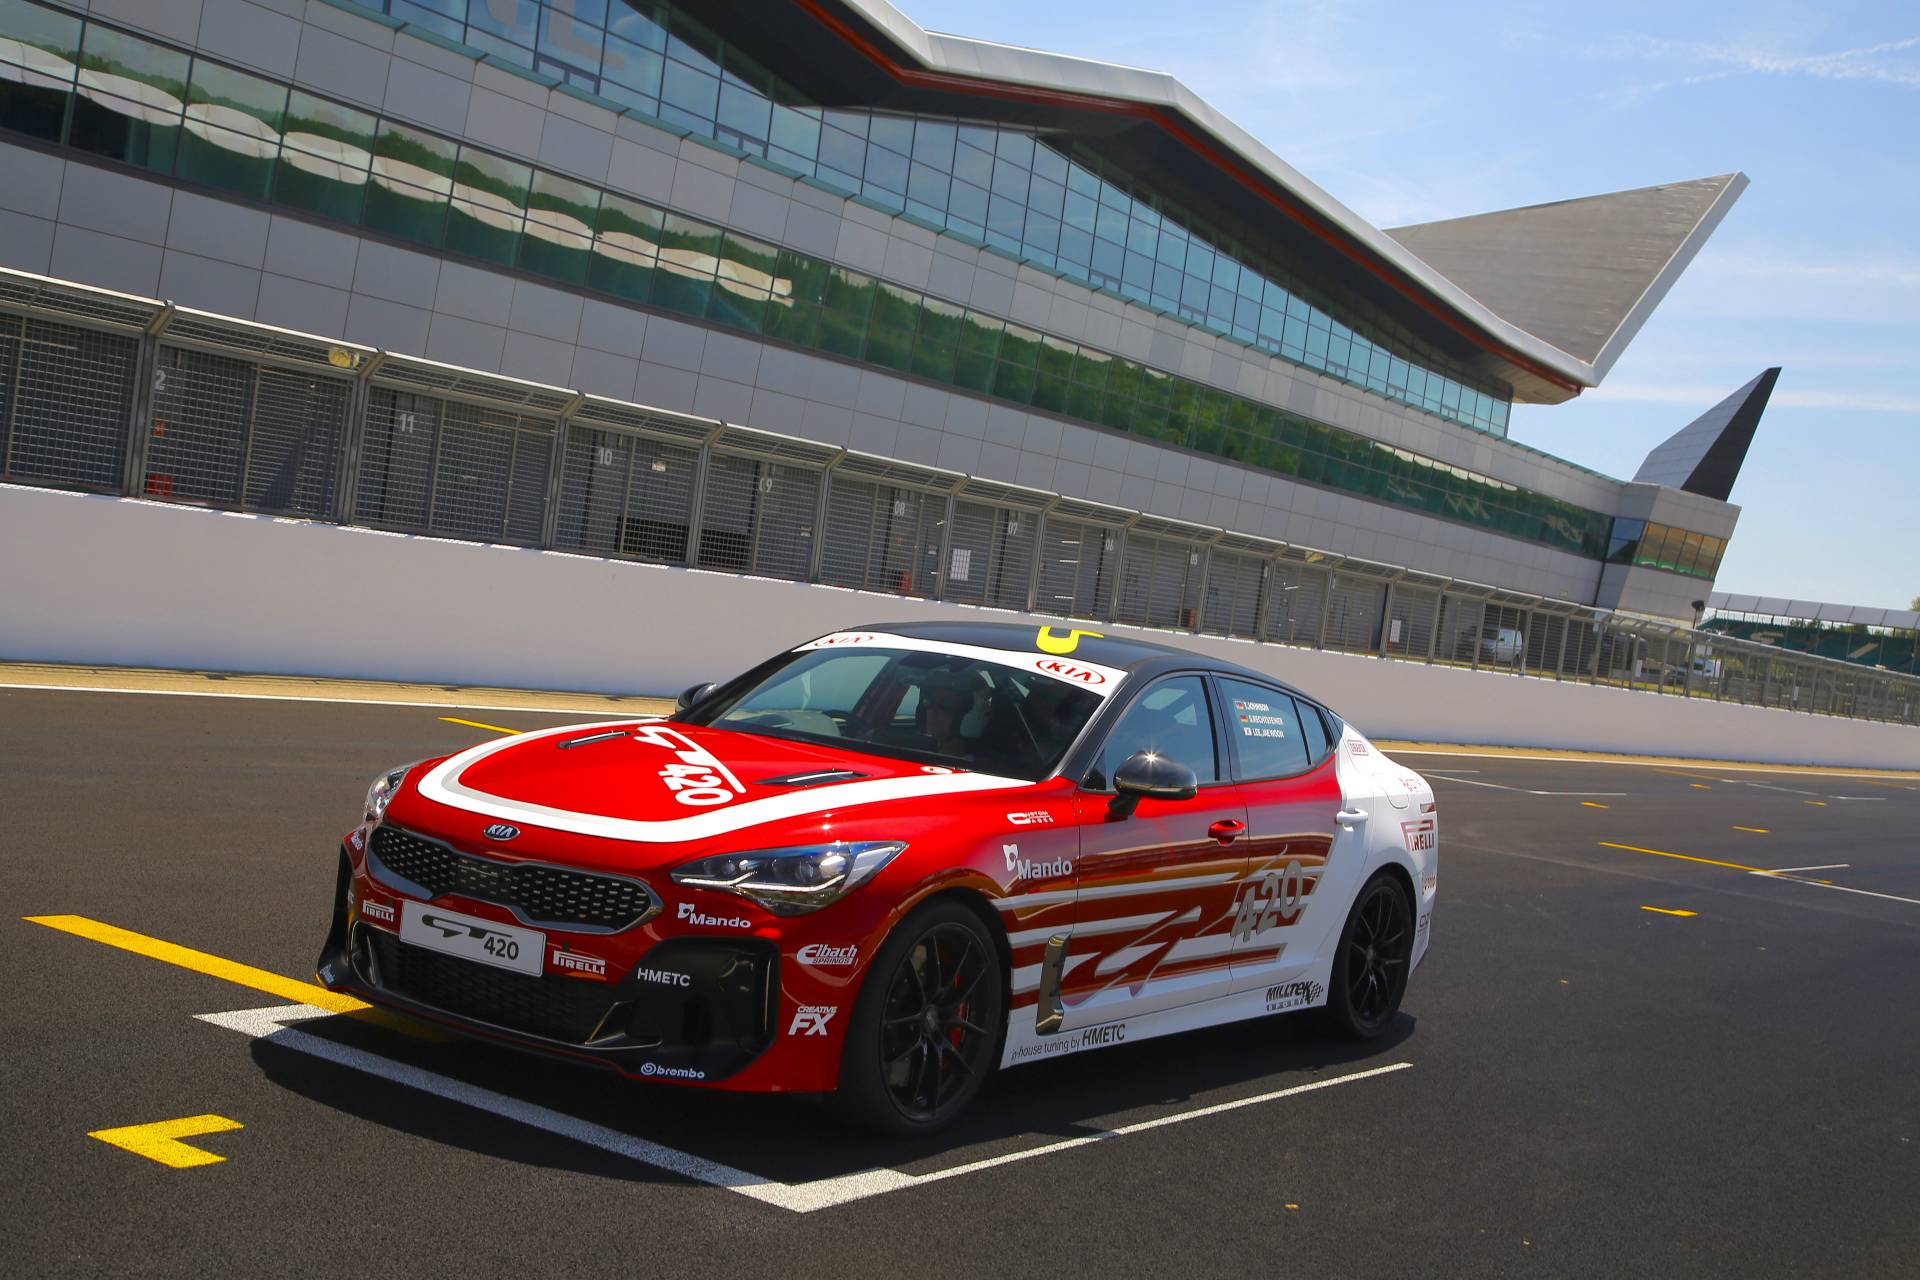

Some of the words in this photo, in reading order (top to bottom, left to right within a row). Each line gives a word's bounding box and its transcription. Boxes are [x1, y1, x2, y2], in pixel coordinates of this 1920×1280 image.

[400, 413, 415, 433] 11
[598, 446, 613, 466] 10
[1045, 661, 1092, 682] KIA
[486, 824, 514, 838] KIA
[1401, 819, 1435, 852] PIRELLI
[1016, 856, 1073, 880] Mando
[363, 899, 395, 922] PIRELLI
[689, 913, 752, 929] Mando
[483, 936, 520, 961] 420
[552, 950, 606, 976] PIRELLI
[637, 967, 691, 988] HMETC
[797, 1005, 839, 1014] CREATIVE
[787, 1012, 836, 1036] FX
[1044, 1037, 1070, 1054] tuning
[1070, 1035, 1081, 1052] by
[1081, 1023, 1126, 1047] HMETC
[656, 1064, 705, 1079] brembo
